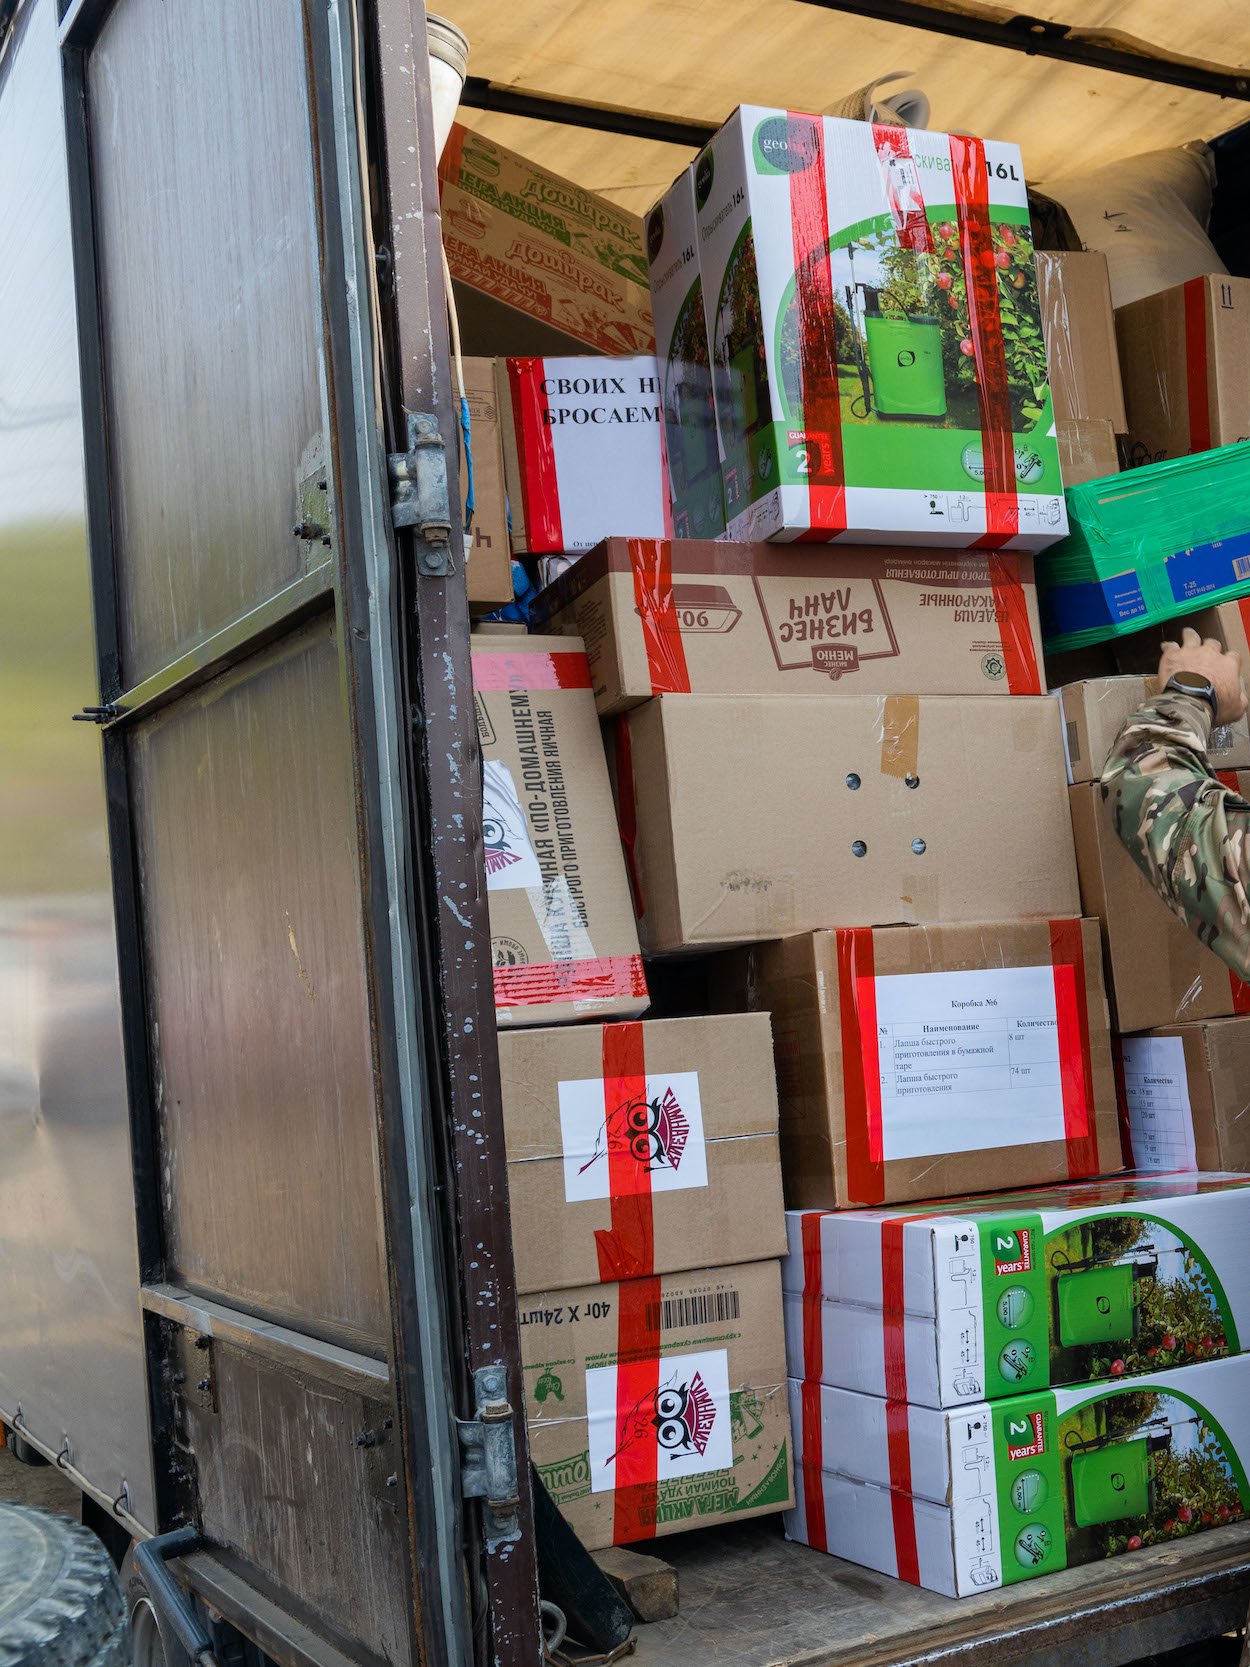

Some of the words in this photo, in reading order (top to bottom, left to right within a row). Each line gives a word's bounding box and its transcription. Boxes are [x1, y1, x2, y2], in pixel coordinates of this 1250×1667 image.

[985, 160, 1019, 182] 16L
[502, 191, 566, 232] АКЦИЯ
[520, 178, 643, 251] Доширак
[444, 233, 481, 266] ЕГА
[482, 254, 547, 295] АКЦИЯ
[446, 252, 500, 283] ОЙМАЙ
[505, 240, 627, 314] Доширак
[540, 377, 627, 395] СВОИХ
[543, 407, 660, 426] БРОСАЕМ
[796, 449, 812, 474] 2
[885, 568, 960, 581] ПРИГОТОВЛЕНИЯ
[789, 587, 851, 620] ЛАНЧ
[779, 608, 874, 643] БИЗНЕС
[953, 609, 1009, 623] ИЗДЕЛИЯ
[816, 650, 854, 661] МЕНЮ
[823, 660, 848, 668] БИЗНЕС
[536, 710, 559, 757] ЯИЧНАЯ
[545, 760, 578, 861] ПРИГОТОВЛЕНИЯ
[951, 999, 983, 1009] Коробка
[984, 998, 998, 1007] №6
[878, 1027, 888, 1035] №
[922, 1023, 980, 1034] Наименование
[894, 1039, 920, 1048] Лапша
[921, 1037, 956, 1047] быстрого
[895, 1049, 950, 1060] приготовления
[957, 1045, 994, 1056] бумажной
[895, 1063, 912, 1071] таре
[1011, 1067, 1019, 1075] 74
[1020, 1067, 1031, 1075] шт
[896, 1074, 922, 1083] Лапша
[923, 1072, 958, 1083] быстрого
[1143, 1076, 1173, 1085] Количество
[897, 1084, 953, 1096] приготовления
[662, 1087, 690, 1171] ГИМНАЗИЯ
[607, 1131, 623, 1150] 26
[997, 1236, 1014, 1251] 2
[1022, 1230, 1031, 1270] GUARANTEE
[997, 1262, 1023, 1276] years
[520, 1307, 563, 1326] 24шт
[584, 1302, 611, 1319] 40г
[584, 1352, 608, 1363] луком
[689, 1371, 717, 1457] ГИМНАЗИЯ
[633, 1419, 649, 1439] 26
[1010, 1420, 1027, 1435] 2
[1036, 1413, 1044, 1453] GUARANTEE
[1010, 1445, 1037, 1461] years
[684, 1476, 736, 1495] ПОЙМАЙ
[745, 1457, 786, 1506] ОБНОВЛЕННЫЙ
[696, 1487, 740, 1515] МЕГА
[638, 1498, 694, 1527] АКЦИЯ
